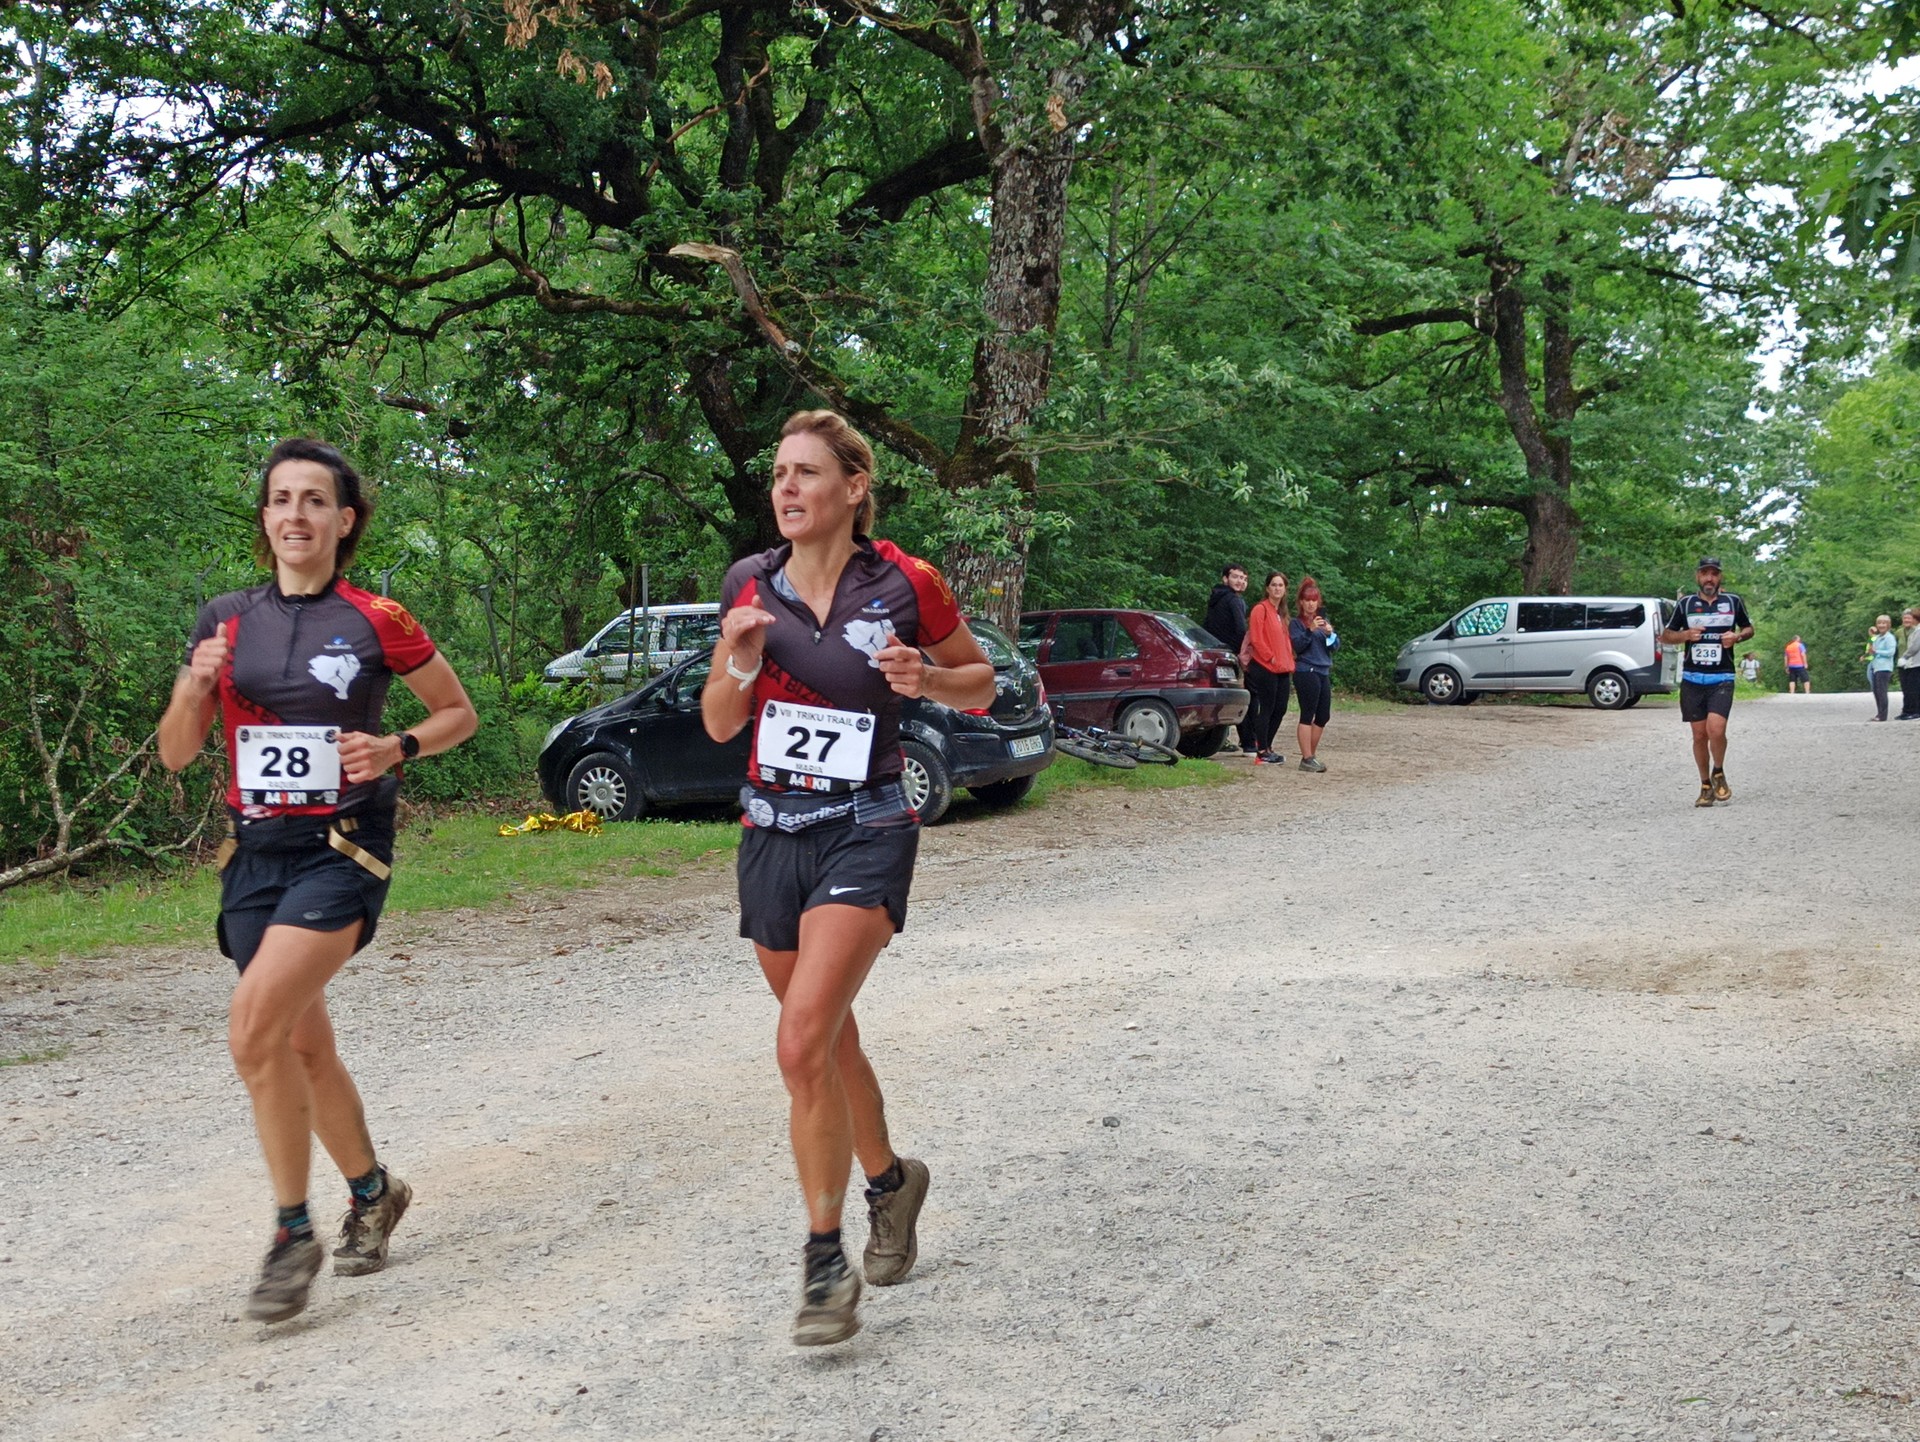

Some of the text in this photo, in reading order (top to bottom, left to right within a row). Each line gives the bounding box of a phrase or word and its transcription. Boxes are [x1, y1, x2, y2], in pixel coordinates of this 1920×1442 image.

[1695, 648, 1717, 658] 238
[796, 710, 826, 722] TRIKU
[826, 714, 854, 727] TRAIL
[266, 731, 293, 740] TRIKU
[295, 732, 322, 740] TRAIL
[785, 725, 841, 763] 27
[260, 746, 311, 778] 28
